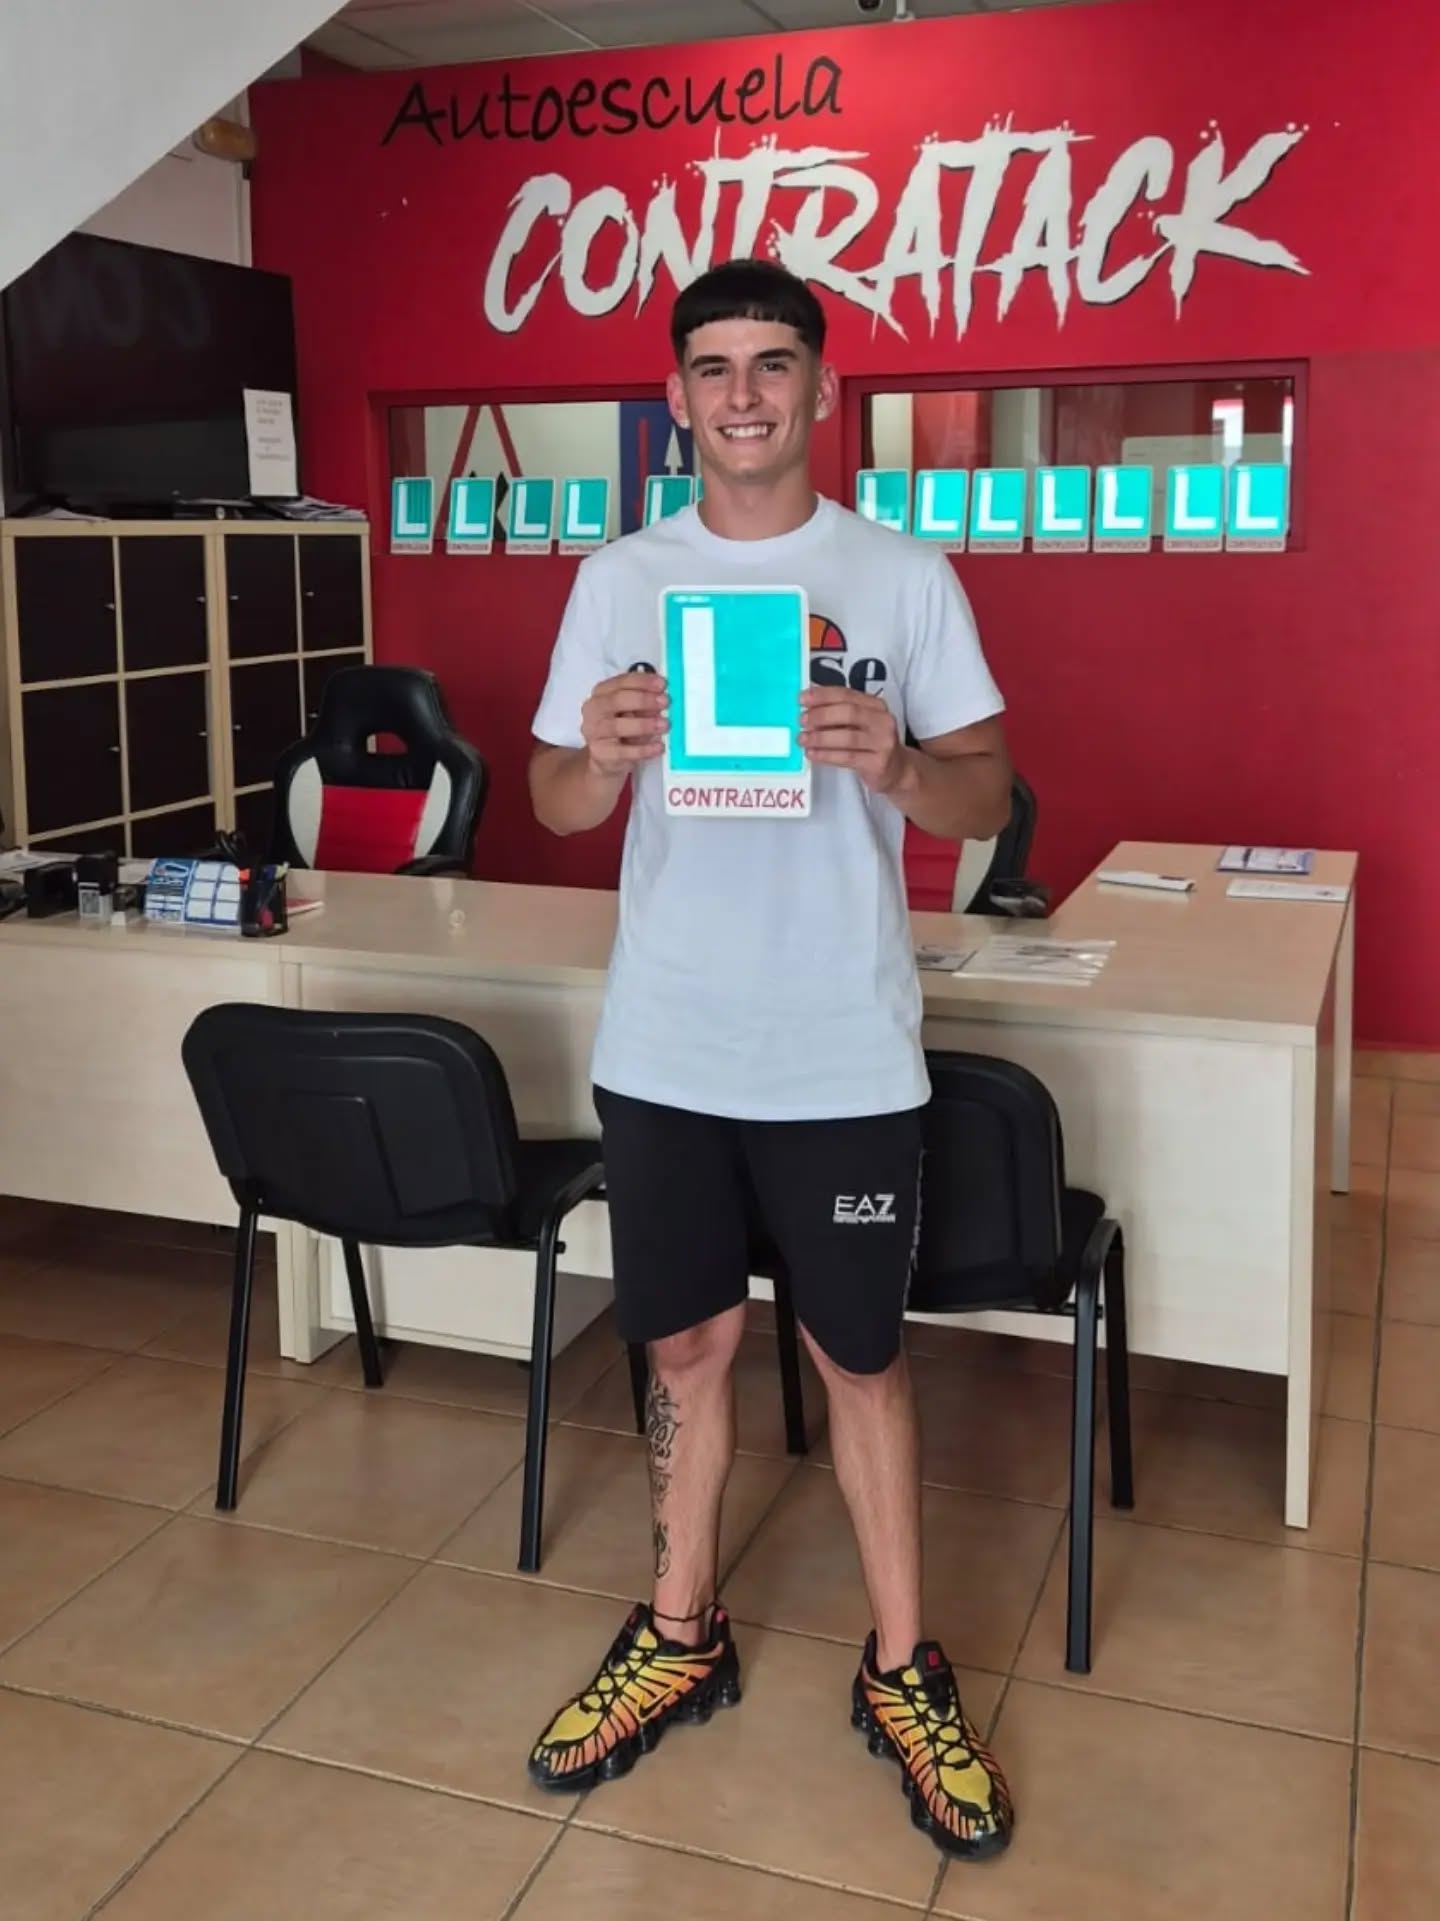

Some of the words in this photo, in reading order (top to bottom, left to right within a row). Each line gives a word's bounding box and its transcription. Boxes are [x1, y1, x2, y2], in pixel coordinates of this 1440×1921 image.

[380, 53, 845, 148] Autoescuela
[483, 113, 1310, 342] CONTRATACK
[397, 484, 428, 535] L
[454, 484, 488, 535] L
[514, 484, 548, 535] L
[566, 484, 601, 535] L
[920, 477, 959, 531] L
[977, 477, 1018, 531] L
[1042, 475, 1083, 531] L
[1102, 470, 1144, 529] L
[1173, 472, 1216, 530] L
[1236, 471, 1279, 529] L
[682, 607, 791, 757] L
[668, 786, 805, 810] CONTRATACK
[834, 1193, 895, 1215] EA7
